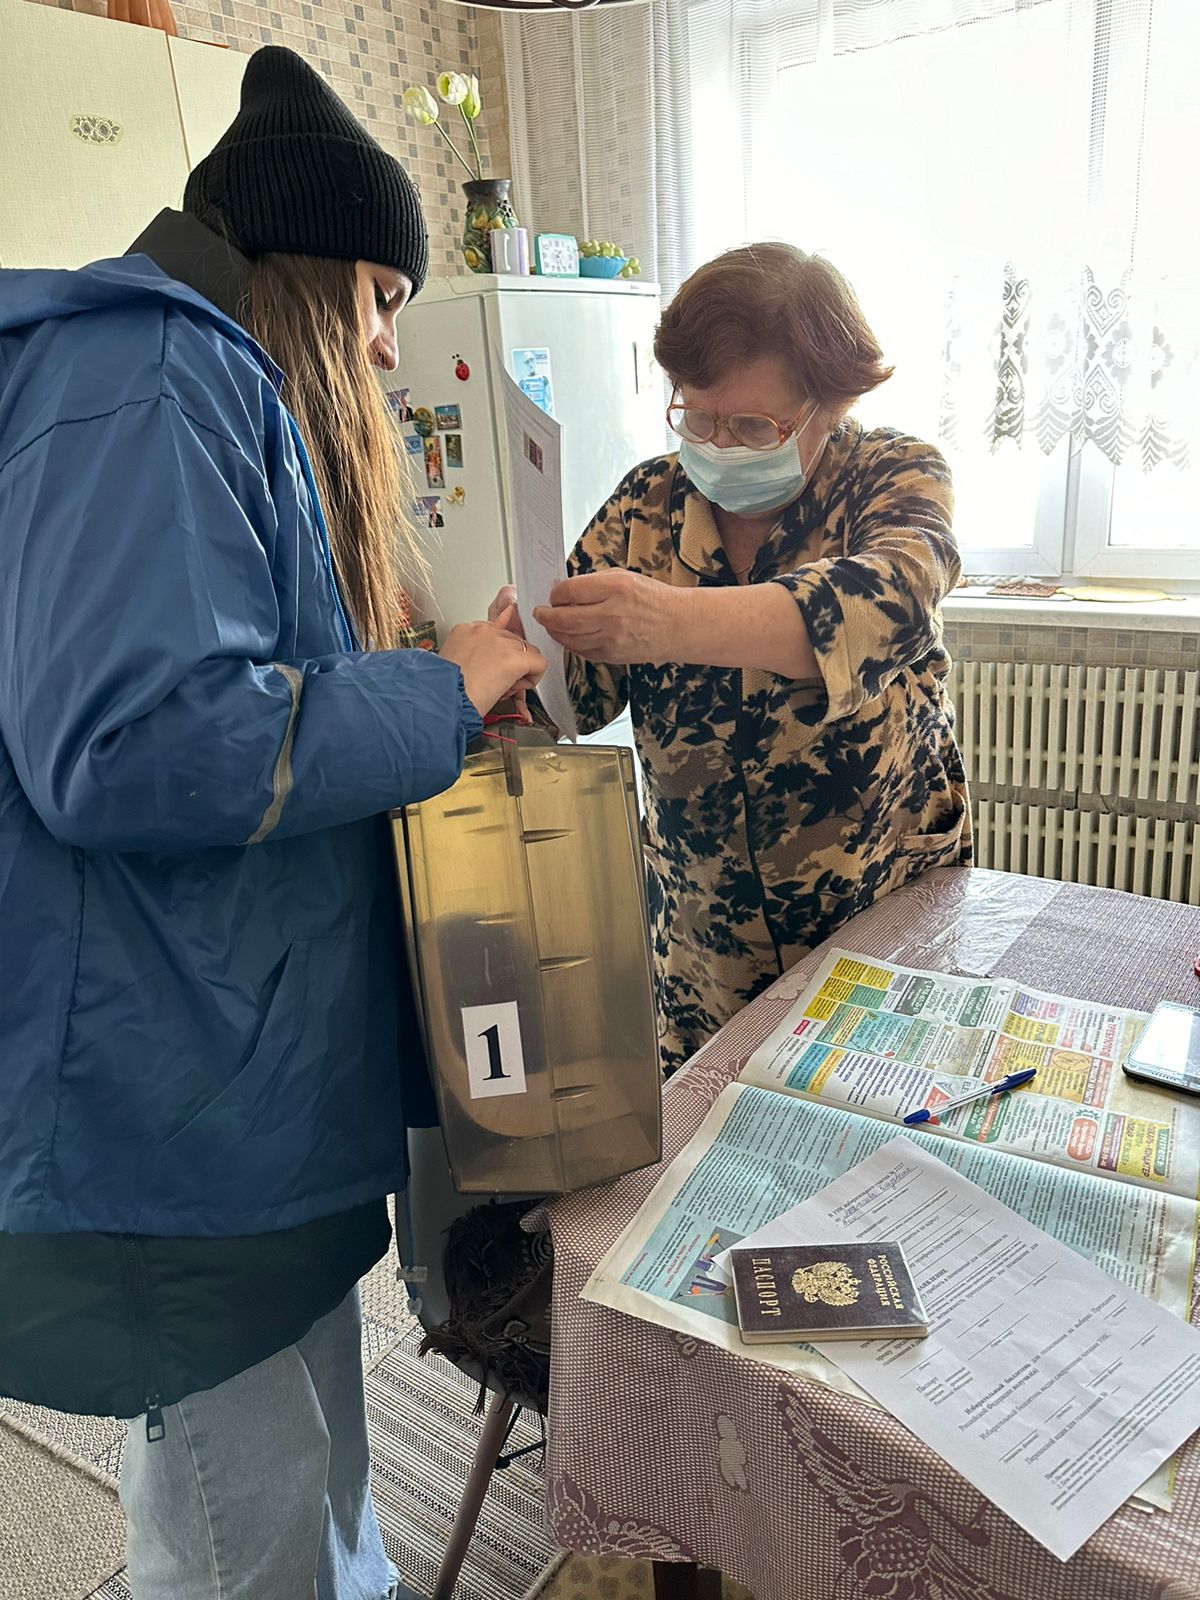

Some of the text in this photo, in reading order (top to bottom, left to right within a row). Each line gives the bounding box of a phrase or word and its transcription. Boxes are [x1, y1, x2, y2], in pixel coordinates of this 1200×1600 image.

[478, 1024, 511, 1080] 1
[752, 1257, 781, 1317] ПАСПОРТ
[867, 1258, 890, 1307] ФЕДЕРАЦИЯ
[877, 1254, 904, 1310] РОССИЙСКАЯ
